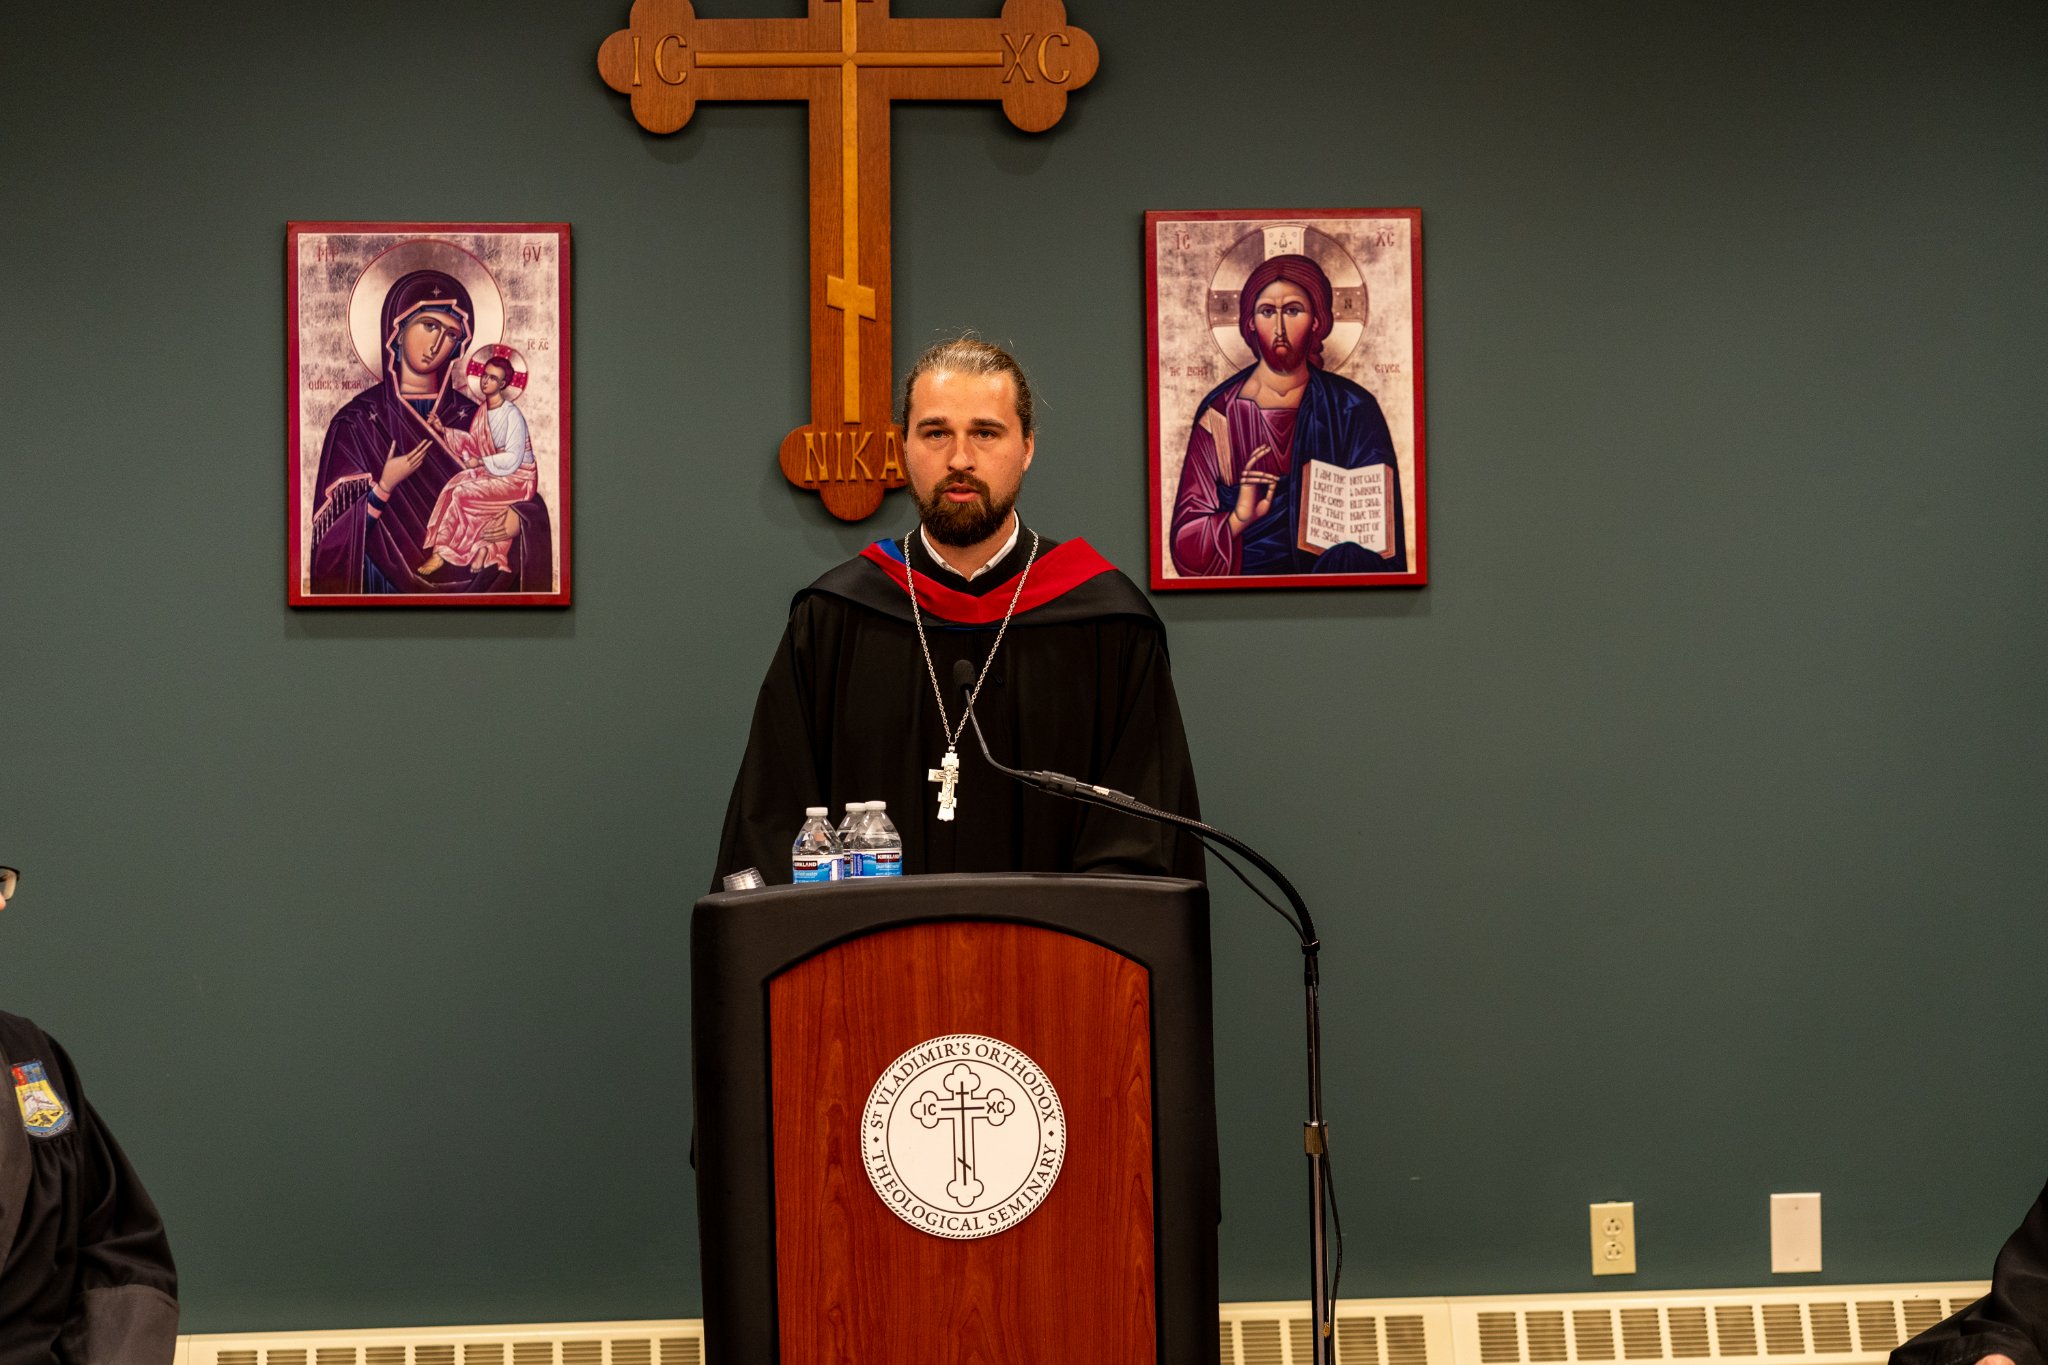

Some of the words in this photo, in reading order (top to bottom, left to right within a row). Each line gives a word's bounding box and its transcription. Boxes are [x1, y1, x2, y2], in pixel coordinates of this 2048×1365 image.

[631, 34, 688, 88] IC
[1002, 32, 1071, 85] XC
[803, 431, 906, 483] NIKA
[876, 1042, 971, 1107] VLADIMIR'S
[975, 1043, 1057, 1124] ORTHODOX
[923, 1103, 938, 1116] IC
[986, 1101, 1006, 1114] XC
[871, 1149, 984, 1232] THEOLOGICAL
[988, 1143, 1057, 1227] SEMINARY
